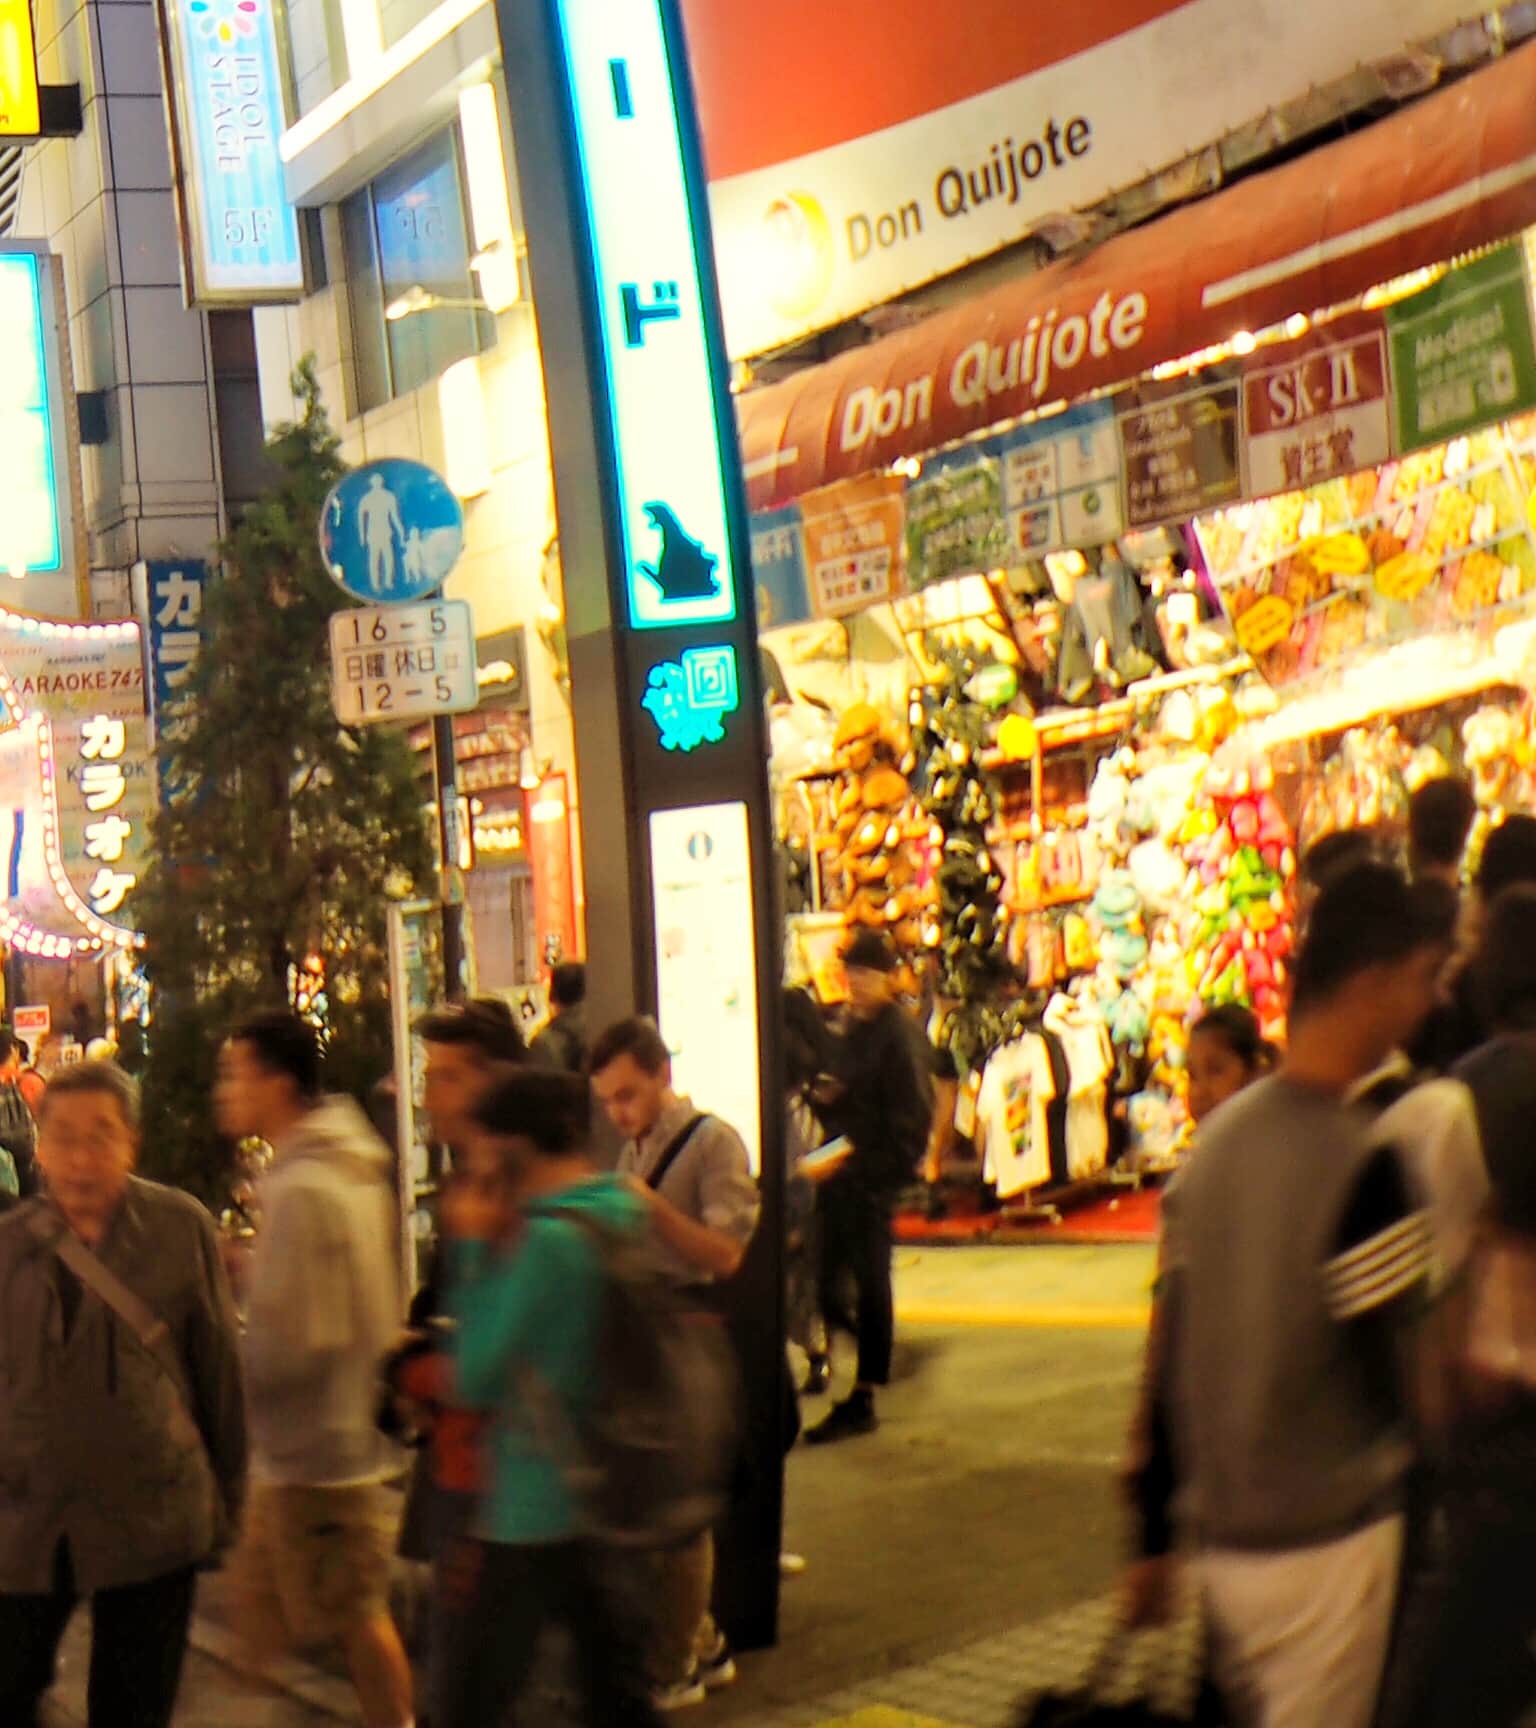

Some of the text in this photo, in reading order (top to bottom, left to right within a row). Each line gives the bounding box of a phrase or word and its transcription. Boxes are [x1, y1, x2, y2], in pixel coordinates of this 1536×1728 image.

[209, 55, 266, 170] IDOL STAGE
[224, 208, 273, 245] 5F
[844, 109, 1094, 264] Don Quijote
[839, 288, 1150, 453] Don Quijote
[110, 668, 145, 688] 747
[80, 714, 137, 916] カラオケ
